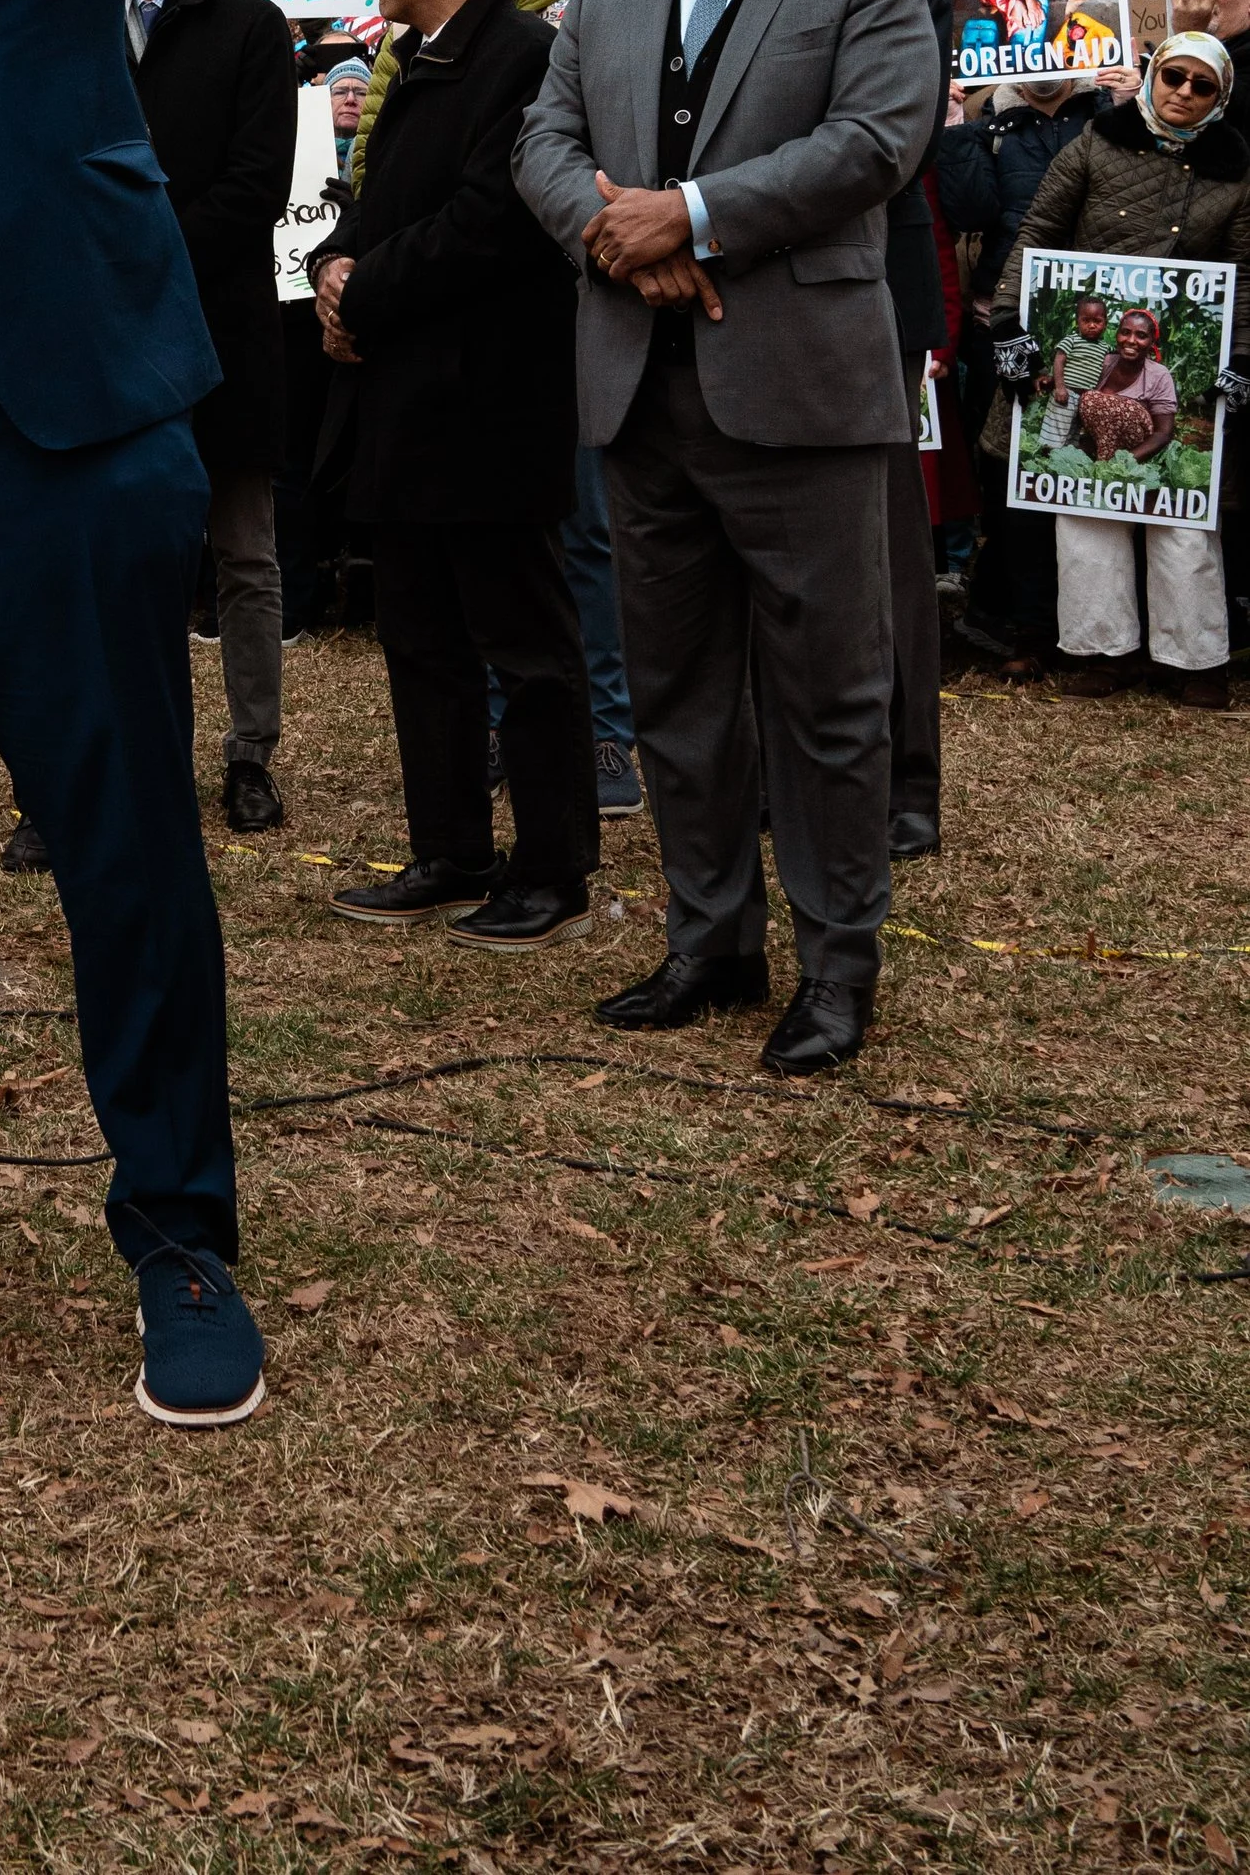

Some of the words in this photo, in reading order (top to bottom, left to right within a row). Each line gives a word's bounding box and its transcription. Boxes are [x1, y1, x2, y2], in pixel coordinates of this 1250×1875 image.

[1072, 36, 1121, 68] AID
[275, 202, 336, 228] rican
[1032, 259, 1088, 292] THE
[1094, 265, 1179, 300] FACES
[1185, 270, 1226, 303] OF
[1018, 470, 1146, 514] FOREIGN
[1153, 486, 1207, 519] AID
